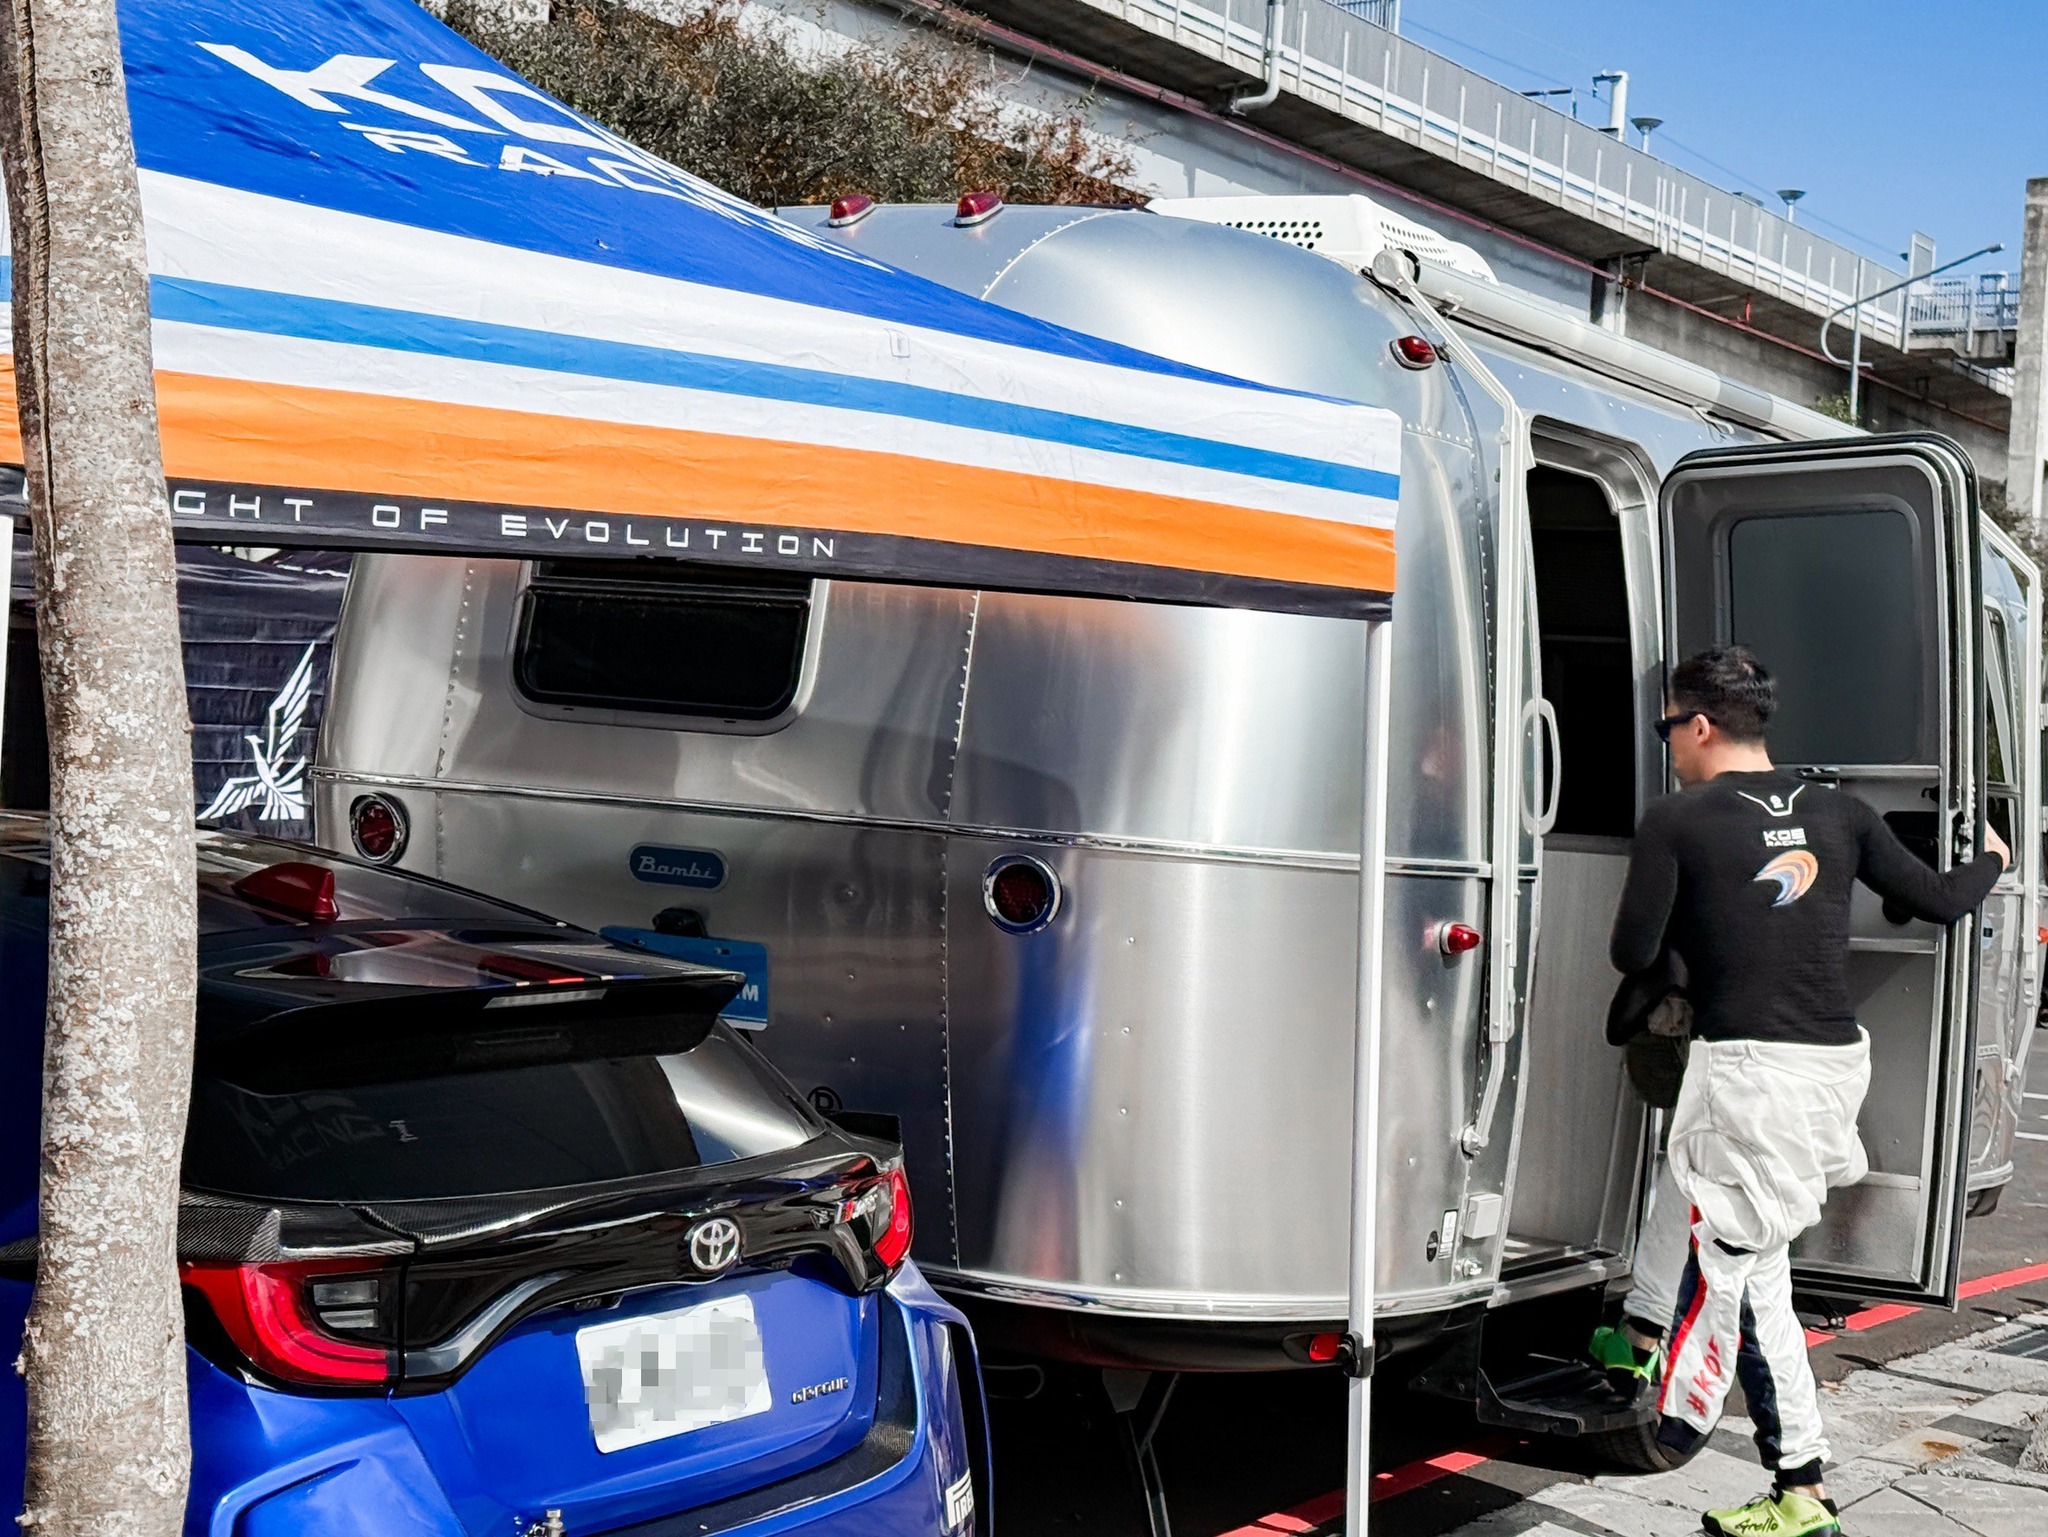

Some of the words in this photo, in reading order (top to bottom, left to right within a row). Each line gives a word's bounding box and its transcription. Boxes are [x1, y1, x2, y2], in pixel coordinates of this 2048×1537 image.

[173, 489, 314, 522] GHT
[371, 504, 448, 531] OF
[501, 514, 835, 558] EVOLUTION
[638, 855, 718, 880] Bambi
